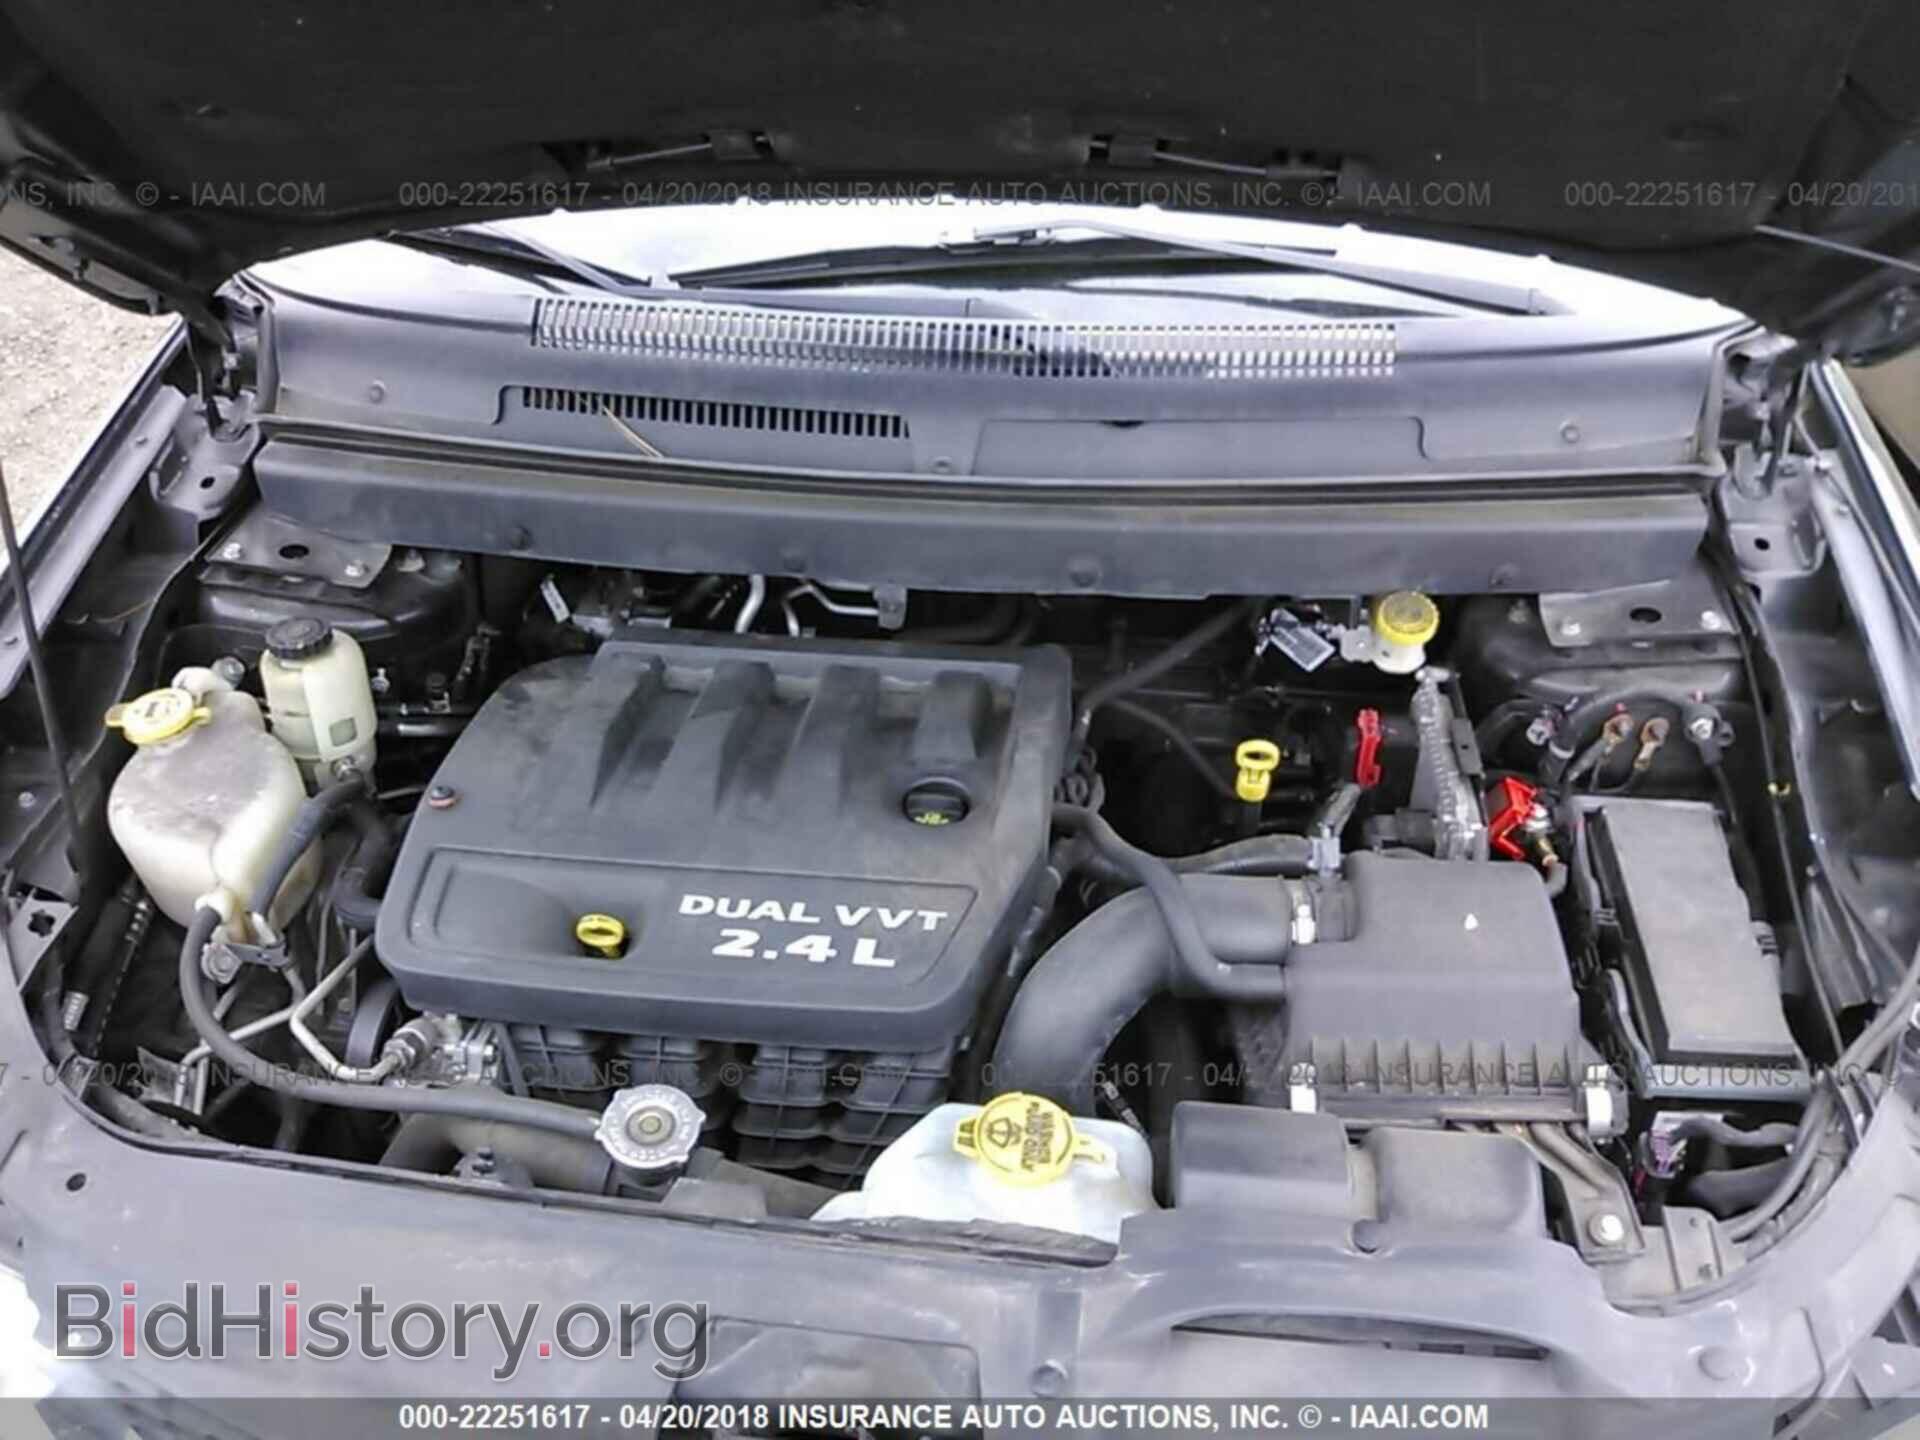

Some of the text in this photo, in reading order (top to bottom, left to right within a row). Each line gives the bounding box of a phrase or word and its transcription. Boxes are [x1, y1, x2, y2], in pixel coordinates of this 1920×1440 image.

[678, 894, 949, 931] DUAL VVT
[712, 928, 897, 968] 2.4 L
